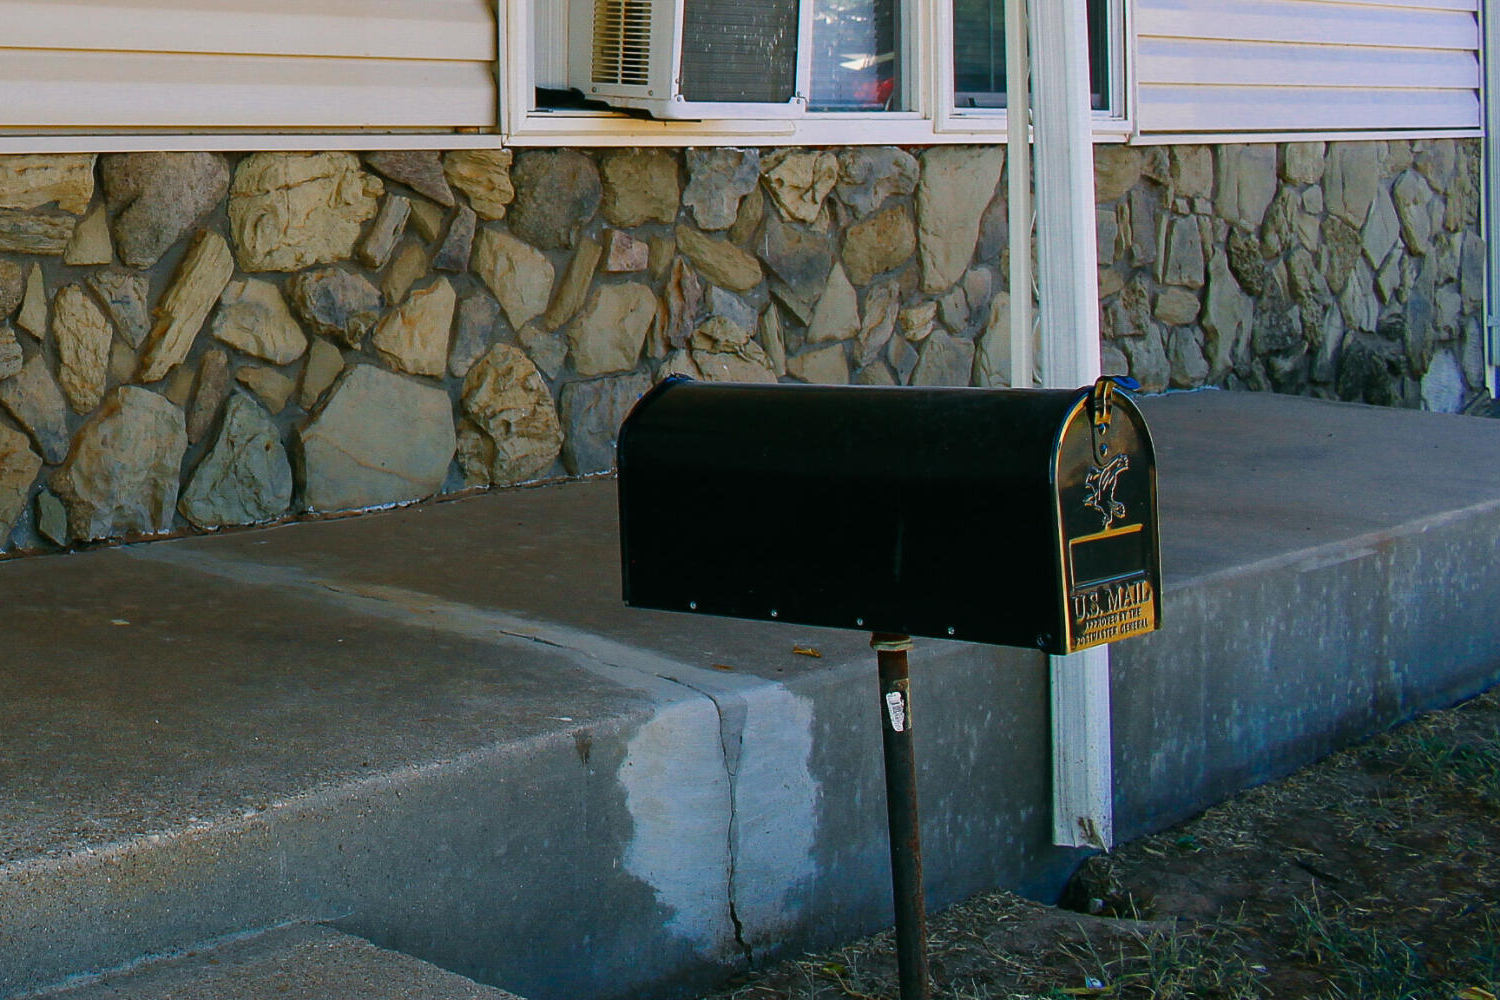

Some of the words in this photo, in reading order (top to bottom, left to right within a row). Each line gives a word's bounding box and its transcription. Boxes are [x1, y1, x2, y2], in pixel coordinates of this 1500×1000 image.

[1072, 591, 1104, 621] U.S.
[1107, 580, 1151, 612] MAIL
[1084, 613, 1119, 633] APPROVED
[1129, 607, 1142, 617] THE
[1120, 618, 1148, 633] GENERAL
